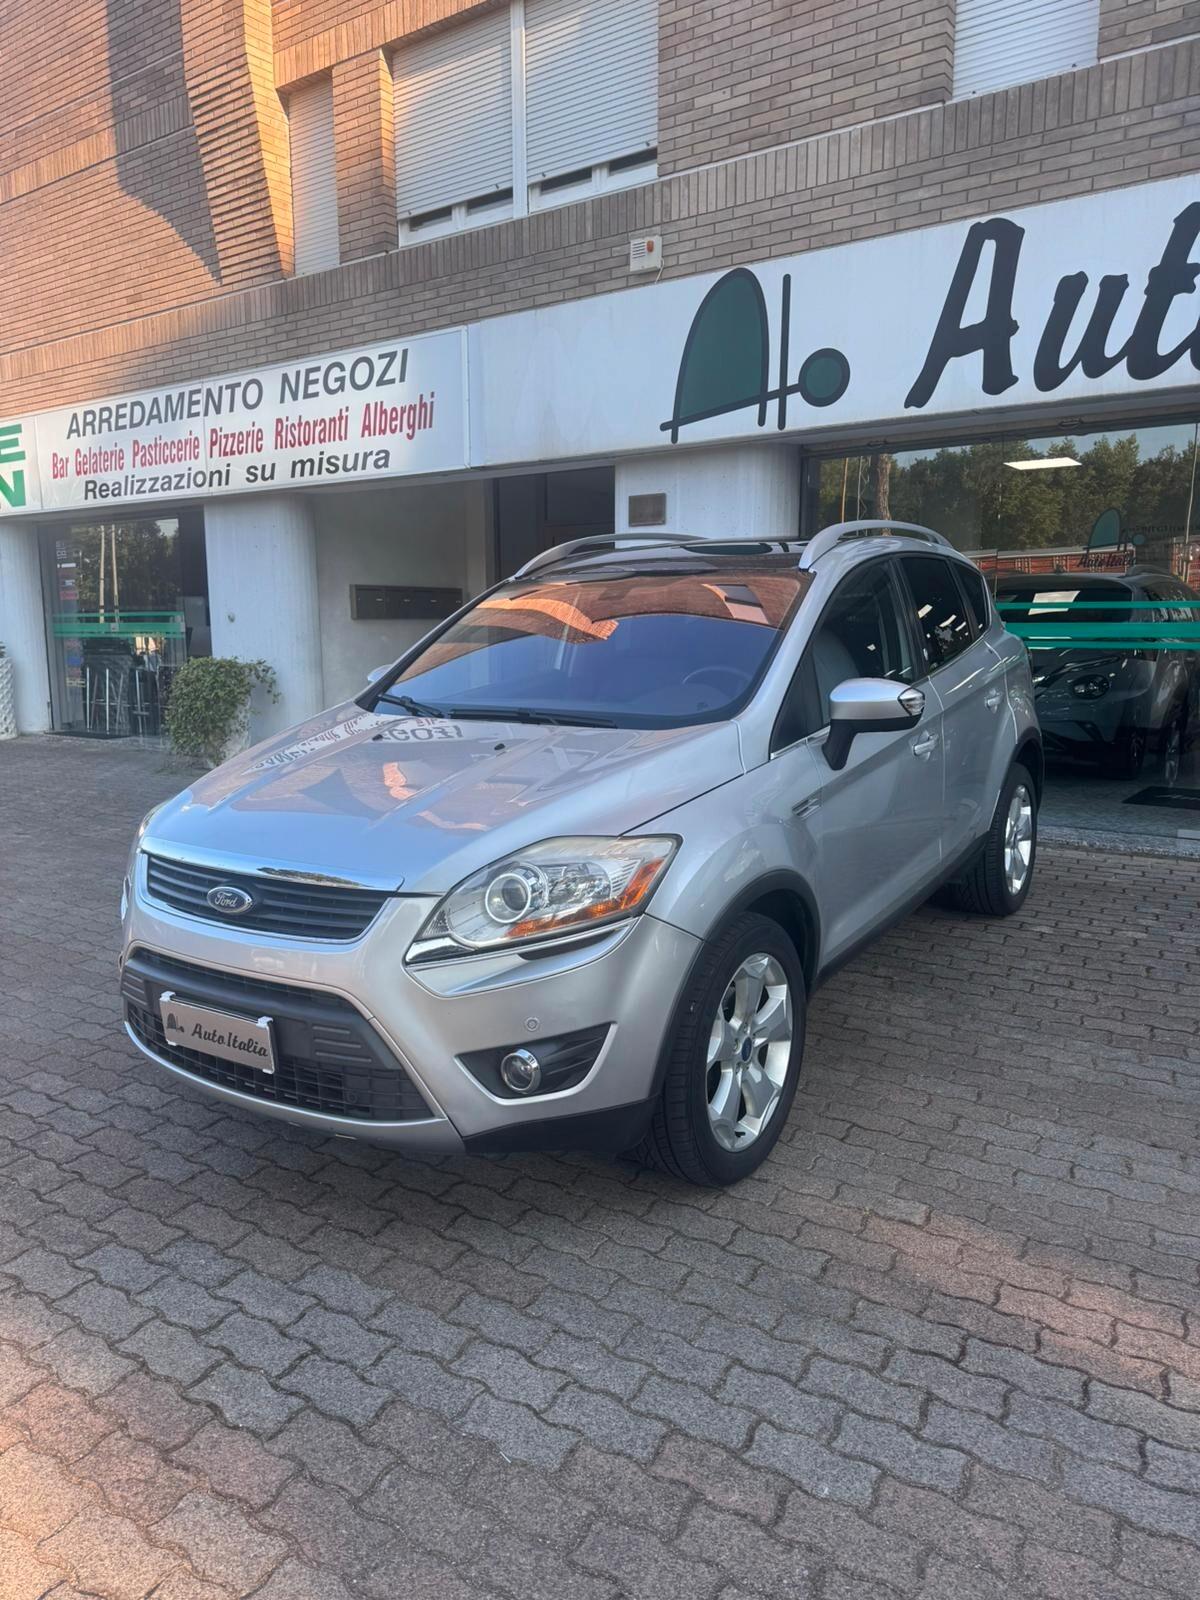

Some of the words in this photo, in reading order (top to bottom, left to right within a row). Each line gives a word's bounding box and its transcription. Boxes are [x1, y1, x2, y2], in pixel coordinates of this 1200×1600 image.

[904, 201, 1200, 409] Aut
[52, 452, 70, 479] Bar
[75, 442, 124, 476] Gelaterie
[132, 430, 200, 468] Pasticcerie
[209, 422, 264, 458] Pizzerie
[274, 406, 349, 450] Ristoranti
[361, 391, 435, 441] Alberghi
[67, 378, 263, 439] ARREDAMENTO
[280, 348, 408, 404] NEGOZI
[84, 463, 231, 500] Realizzazioni
[245, 462, 276, 483] su
[290, 449, 390, 478] misura
[214, 891, 238, 907] Ford
